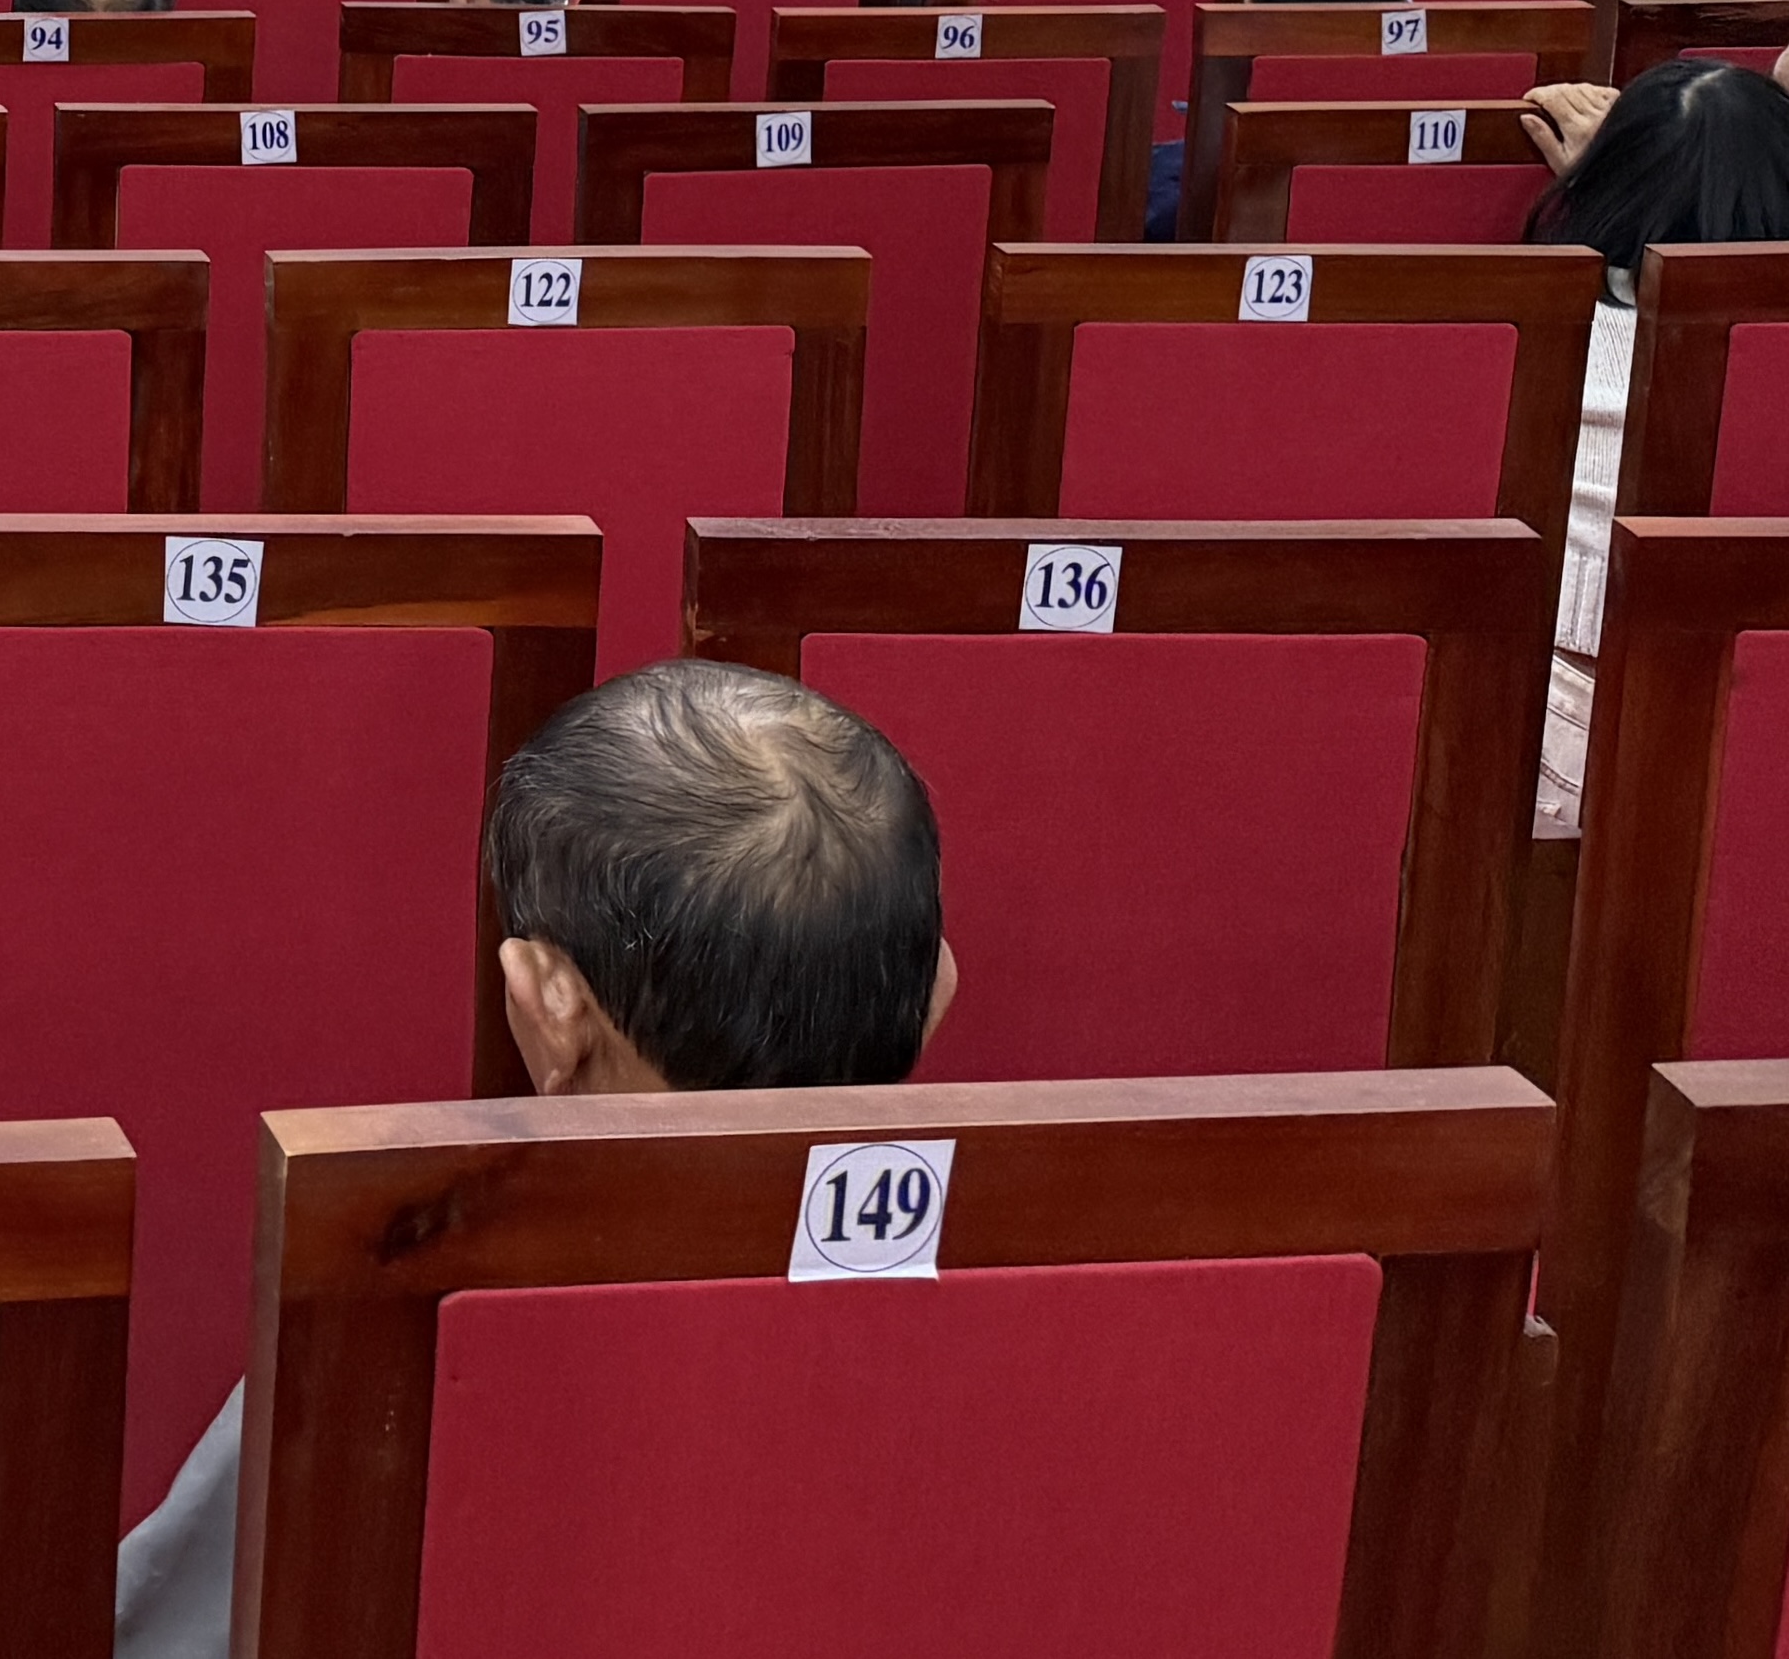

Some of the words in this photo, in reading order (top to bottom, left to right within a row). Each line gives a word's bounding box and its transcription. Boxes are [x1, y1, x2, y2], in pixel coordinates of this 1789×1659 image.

[30, 27, 63, 50] 94
[527, 19, 560, 45] 95
[943, 25, 975, 50] 96
[1388, 18, 1421, 44] 97
[249, 120, 289, 151] 108
[765, 122, 804, 153] 109
[1417, 120, 1457, 150] 110
[521, 272, 571, 308] 122
[1252, 269, 1303, 304] 123
[175, 553, 251, 605] 135
[1034, 561, 1111, 611] 136
[820, 1168, 931, 1242] 149
